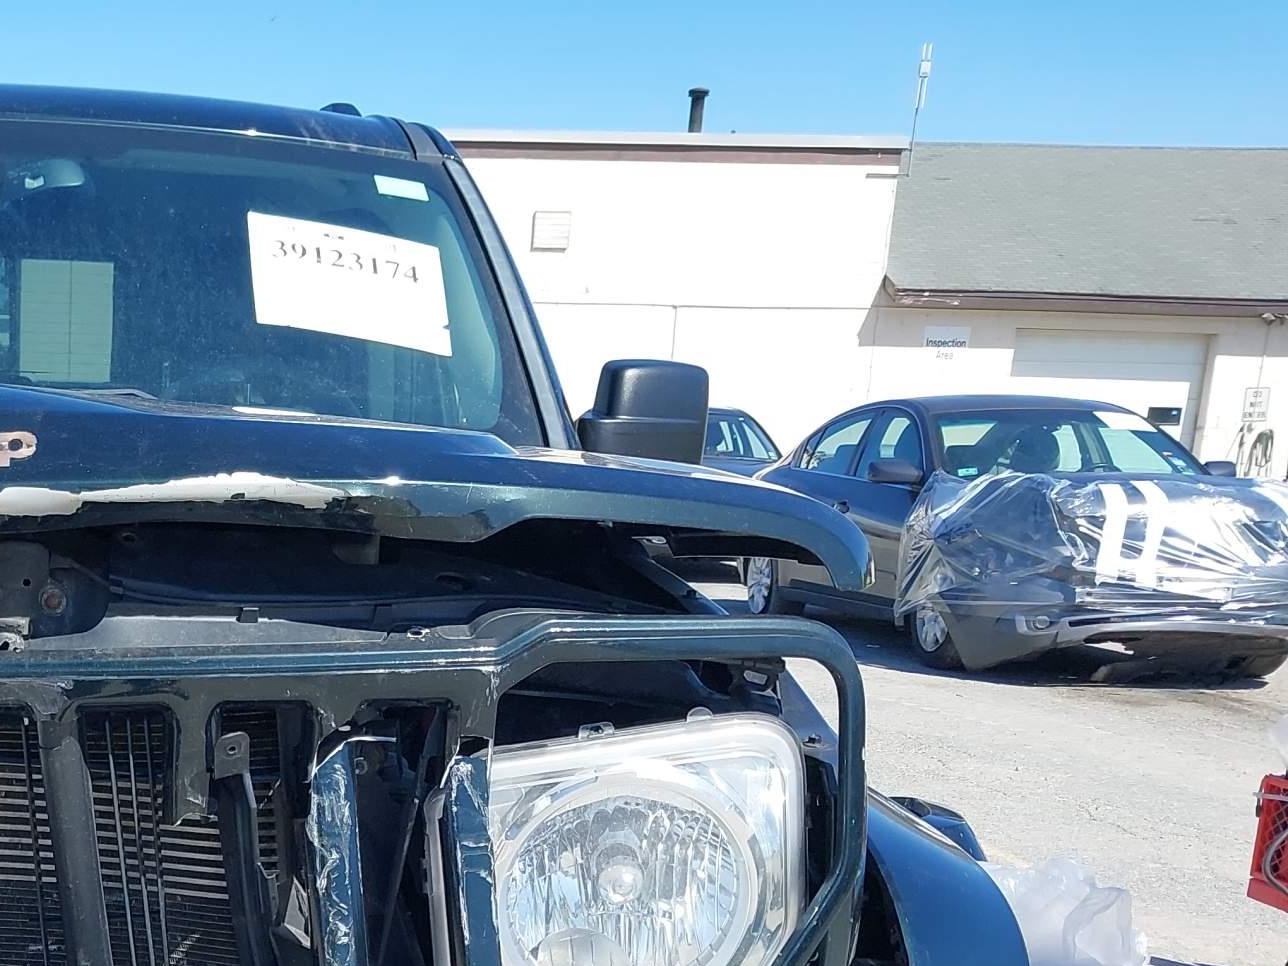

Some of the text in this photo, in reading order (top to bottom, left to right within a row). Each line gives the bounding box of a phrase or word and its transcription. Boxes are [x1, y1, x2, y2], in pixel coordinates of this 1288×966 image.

[272, 239, 420, 283] 39123174
[925, 337, 967, 348] Inspection
[936, 351, 954, 360] Area
